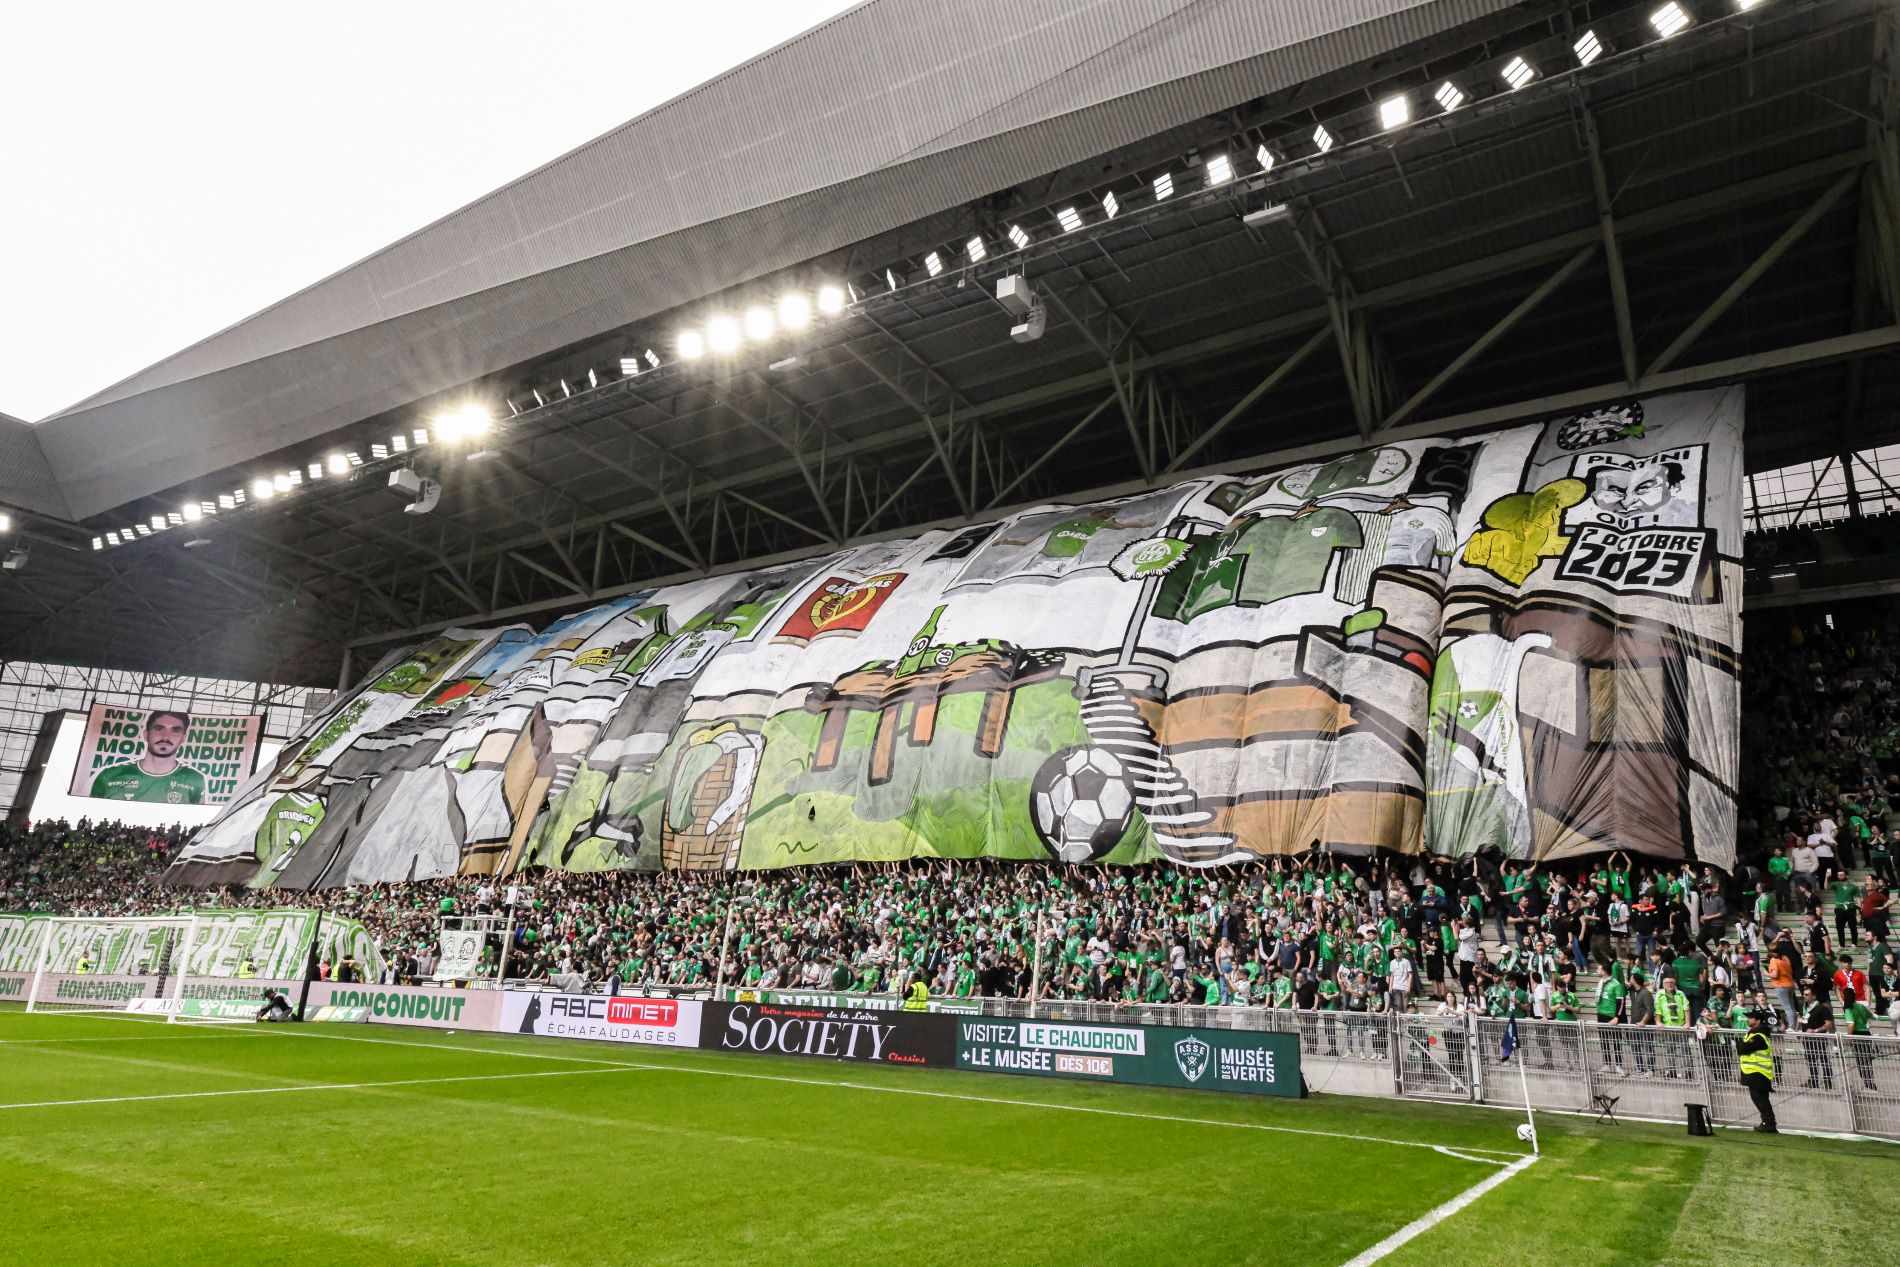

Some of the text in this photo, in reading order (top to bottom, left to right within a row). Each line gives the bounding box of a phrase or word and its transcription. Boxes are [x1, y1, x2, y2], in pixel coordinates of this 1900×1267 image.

[1588, 450, 1690, 470] PLATINI
[1596, 512, 1644, 529] OUT
[1581, 528, 1703, 552] 7 OCTOBRE
[1567, 542, 1695, 586] 2023
[330, 990, 466, 1022] MONCONDUIT
[550, 997, 675, 1021] ABC MINET
[760, 1004, 879, 1022] Votre magazine de la Loire
[547, 1022, 677, 1042] ÉCHAFAUDAGES
[722, 1004, 896, 1060] SOCIETY
[962, 1023, 1138, 1052] VISITEZ LE CHAUDRON
[888, 1052, 927, 1064] Classics
[1180, 1044, 1206, 1056] ASSE
[1221, 1047, 1275, 1068] MUSÉE
[995, 1048, 1052, 1071] MUSÉE
[1059, 1055, 1084, 1071] DÈS
[1086, 1058, 1109, 1073] 10€
[1221, 1065, 1231, 1080] DES
[1230, 1066, 1276, 1083] VERTS
